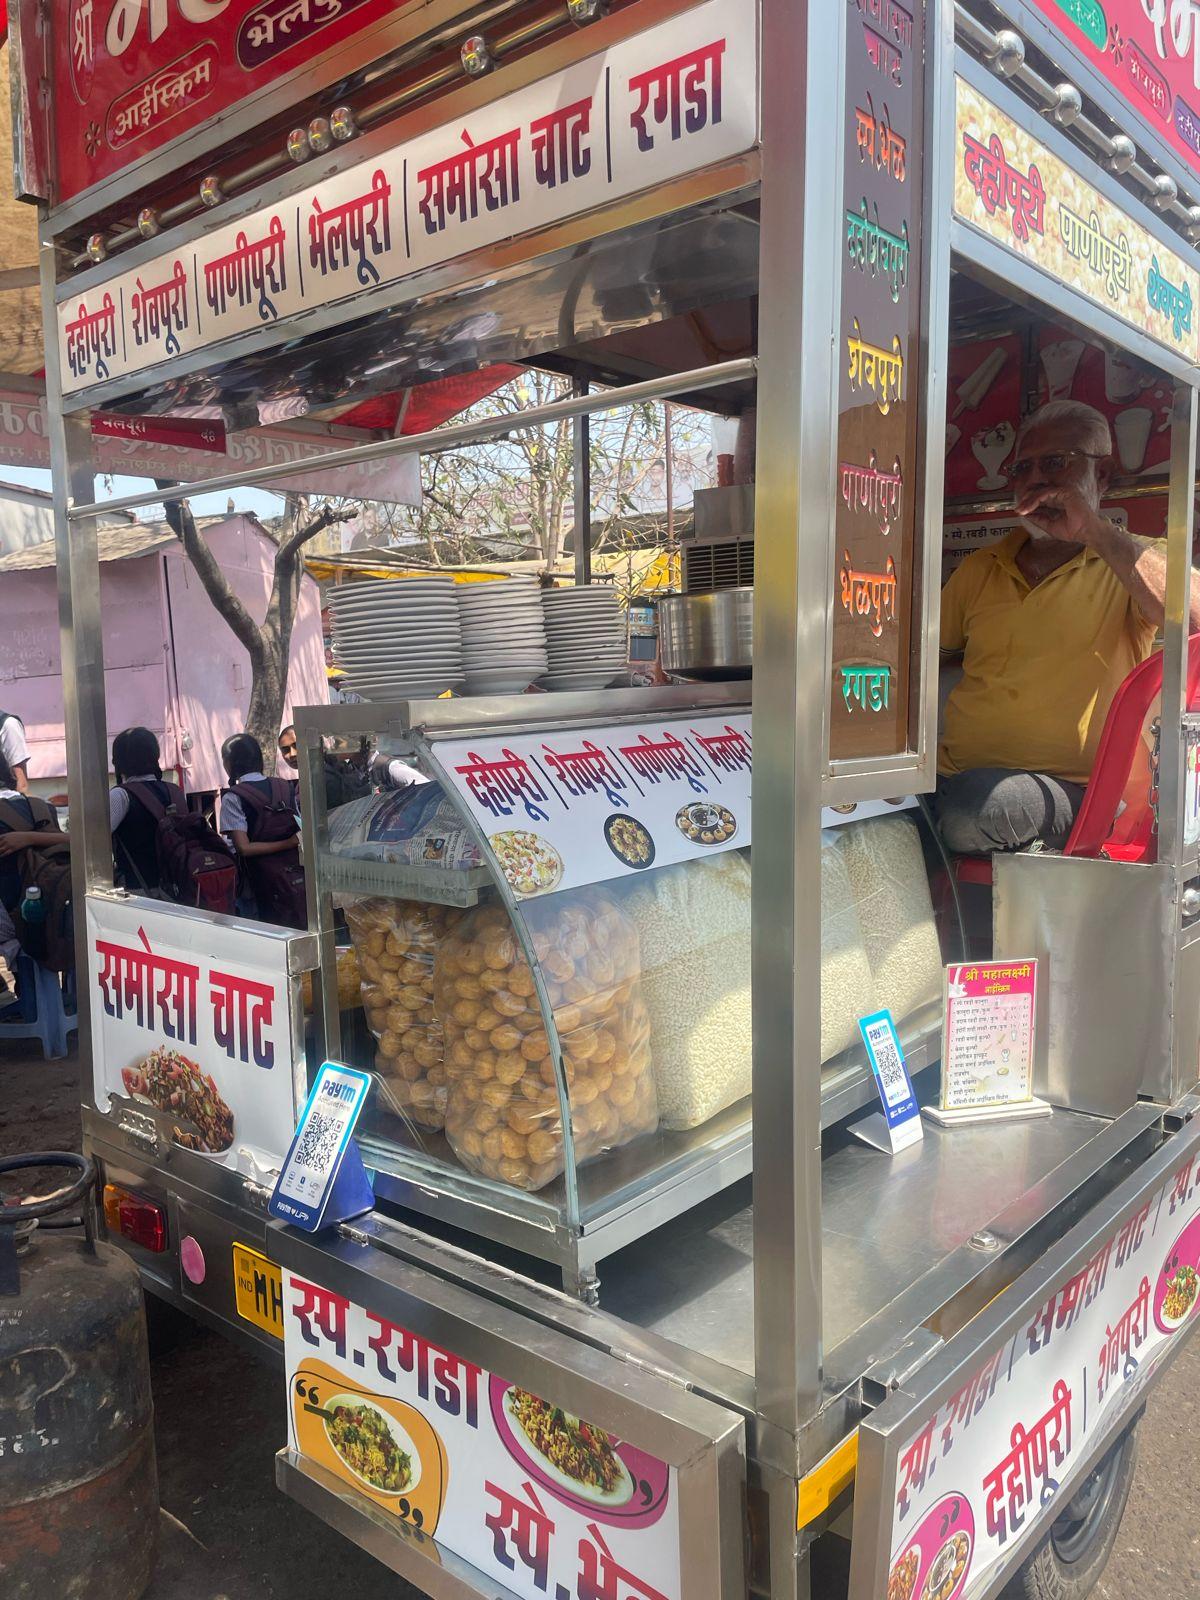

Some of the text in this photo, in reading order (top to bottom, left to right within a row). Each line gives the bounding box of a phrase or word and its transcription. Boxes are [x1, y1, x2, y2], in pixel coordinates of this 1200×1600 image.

[65, 38, 726, 379] दहीपूरी शेवपूरी पाणीपूरी भेलपूरी समोसा चाट रगडा
[963, 132, 1193, 341] दहीपूरी पाणीपूरी शेवपूरी
[840, 665, 891, 713] रगडा
[454, 748, 550, 822] दहीपूरी
[541, 740, 629, 808] शेवपूरी
[619, 732, 709, 794] पाणीपूरी
[96, 925, 275, 1070] समोसा चाट
[965, 964, 1031, 982] श्री महालक्ष्मी
[238, 1276, 253, 1293] IND
[982, 1378, 1072, 1547] दहीपूरी
